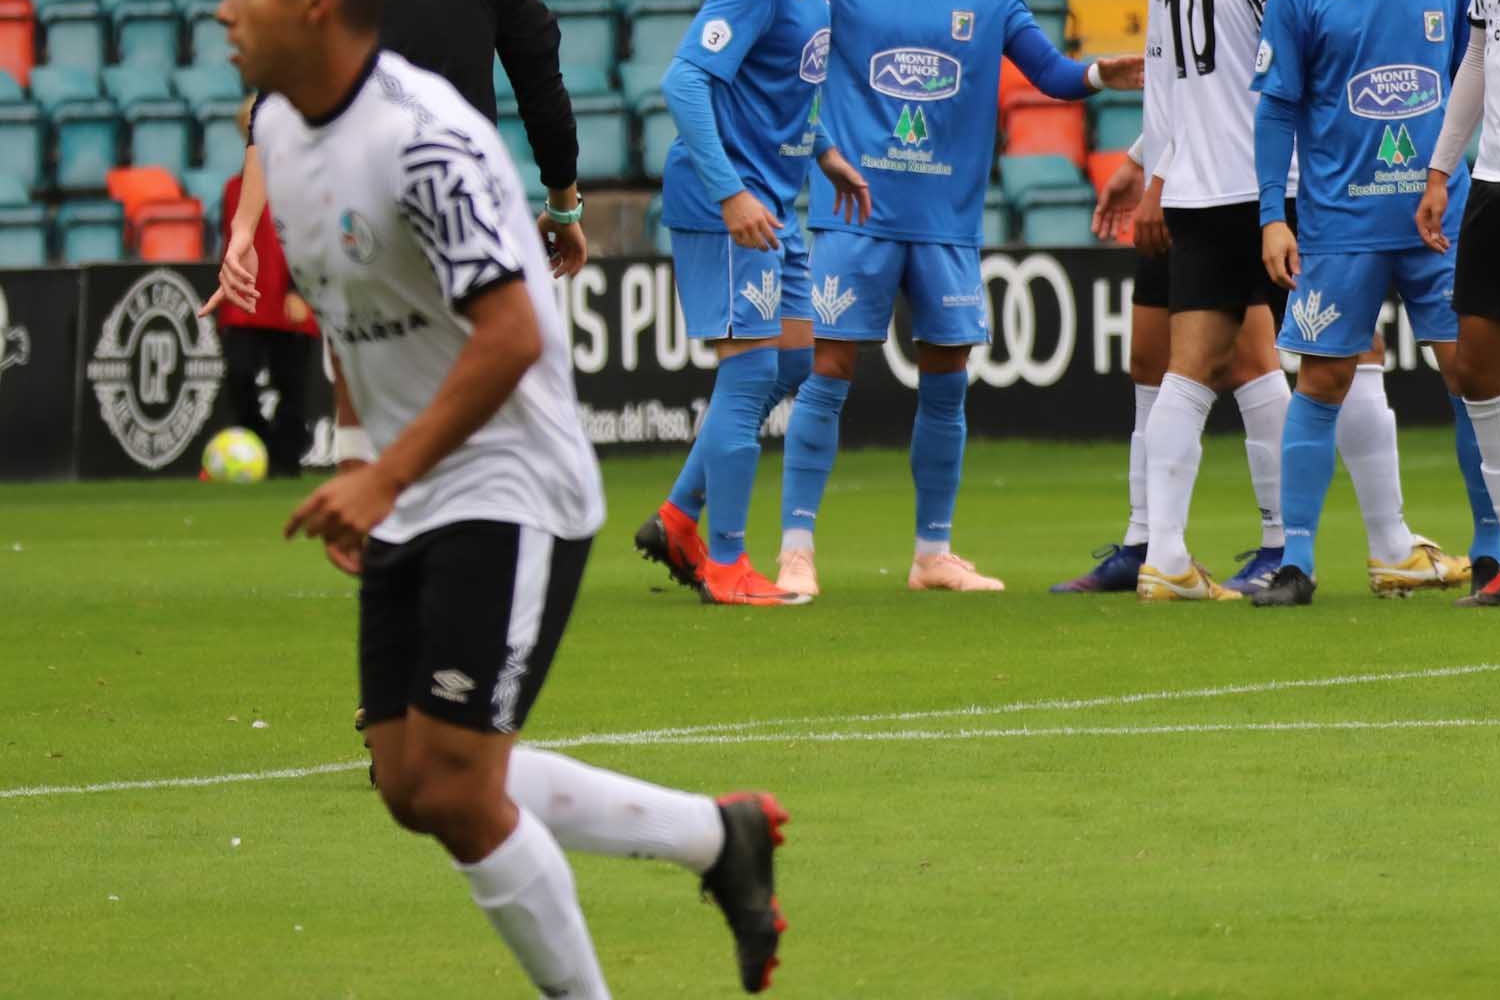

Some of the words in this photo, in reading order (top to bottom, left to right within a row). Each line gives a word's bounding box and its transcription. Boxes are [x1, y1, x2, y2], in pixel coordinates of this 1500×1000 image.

[894, 53, 940, 66] MONTE
[900, 64, 940, 76] PINOS
[1370, 69, 1418, 83] MONTE
[1377, 80, 1419, 94] PINOS
